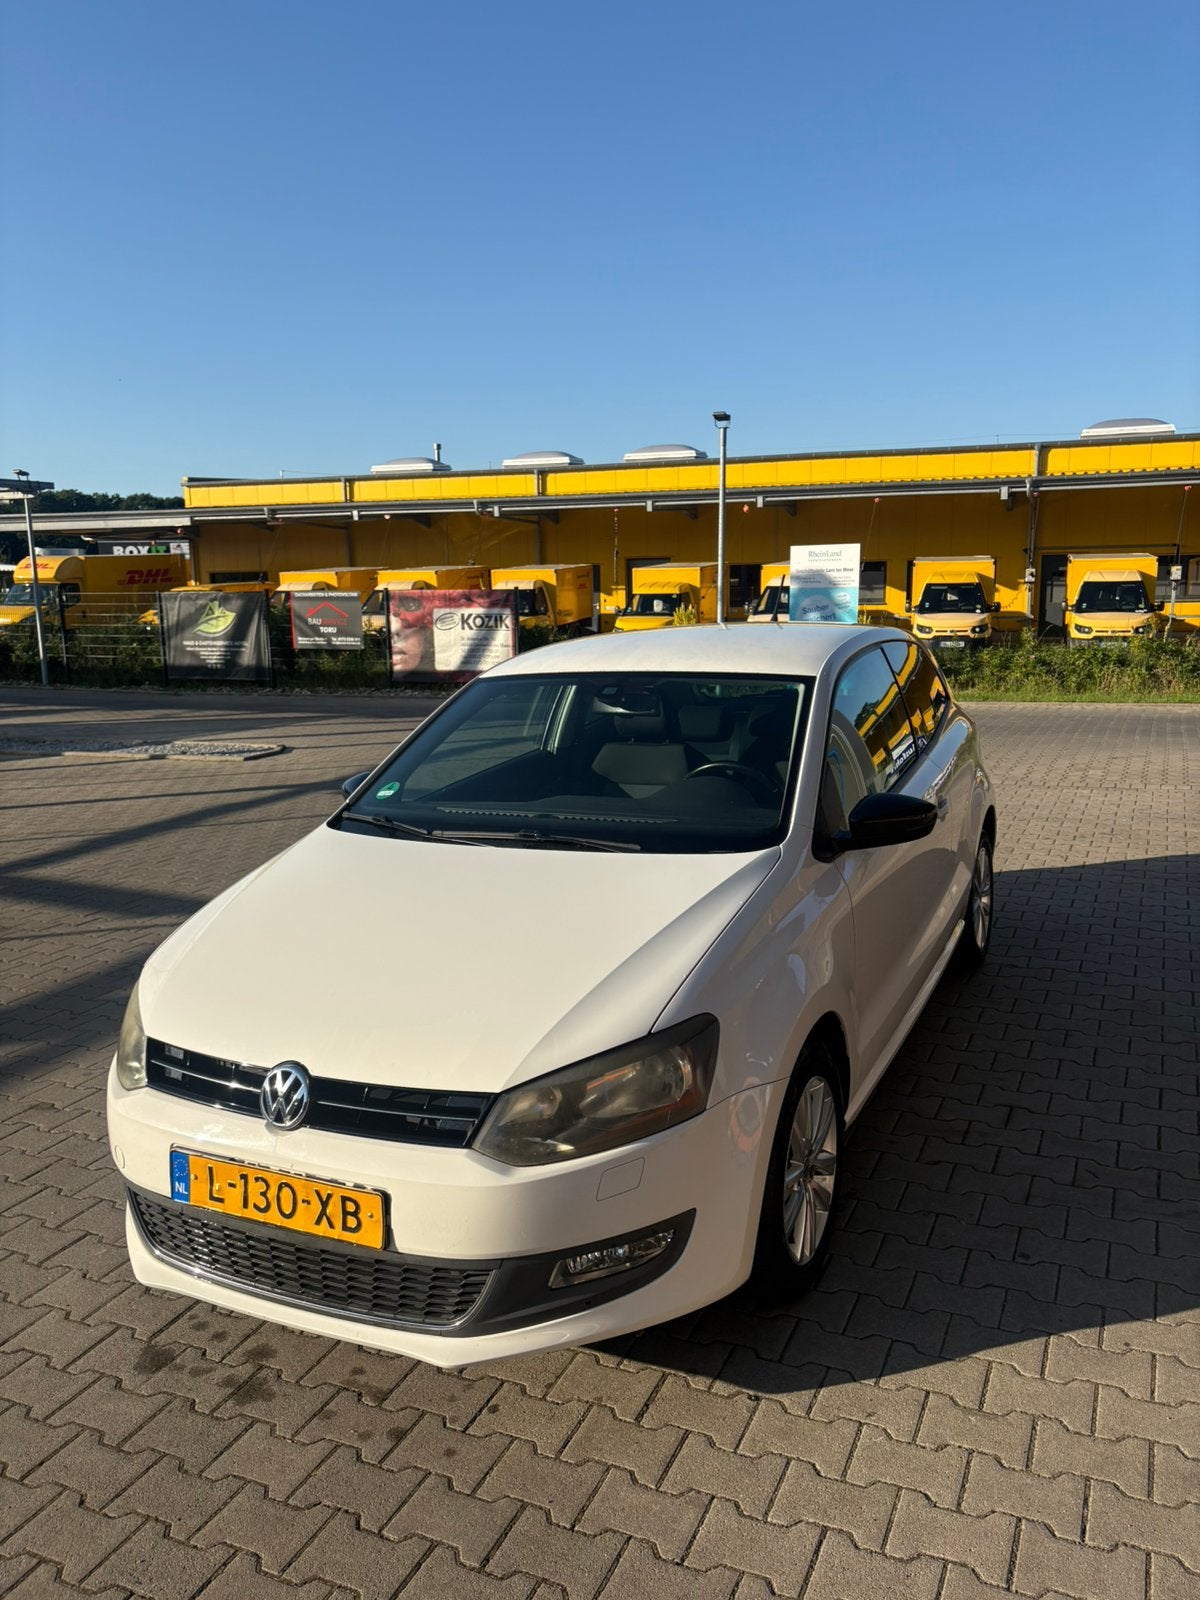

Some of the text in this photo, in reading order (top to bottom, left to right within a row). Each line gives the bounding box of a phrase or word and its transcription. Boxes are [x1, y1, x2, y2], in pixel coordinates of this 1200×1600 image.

[808, 550, 842, 558] RheinLand
[127, 568, 173, 584] DHL
[802, 604, 829, 615] Sauber
[461, 613, 510, 630] KOZIK
[174, 1164, 362, 1234] NL L-130-XB
